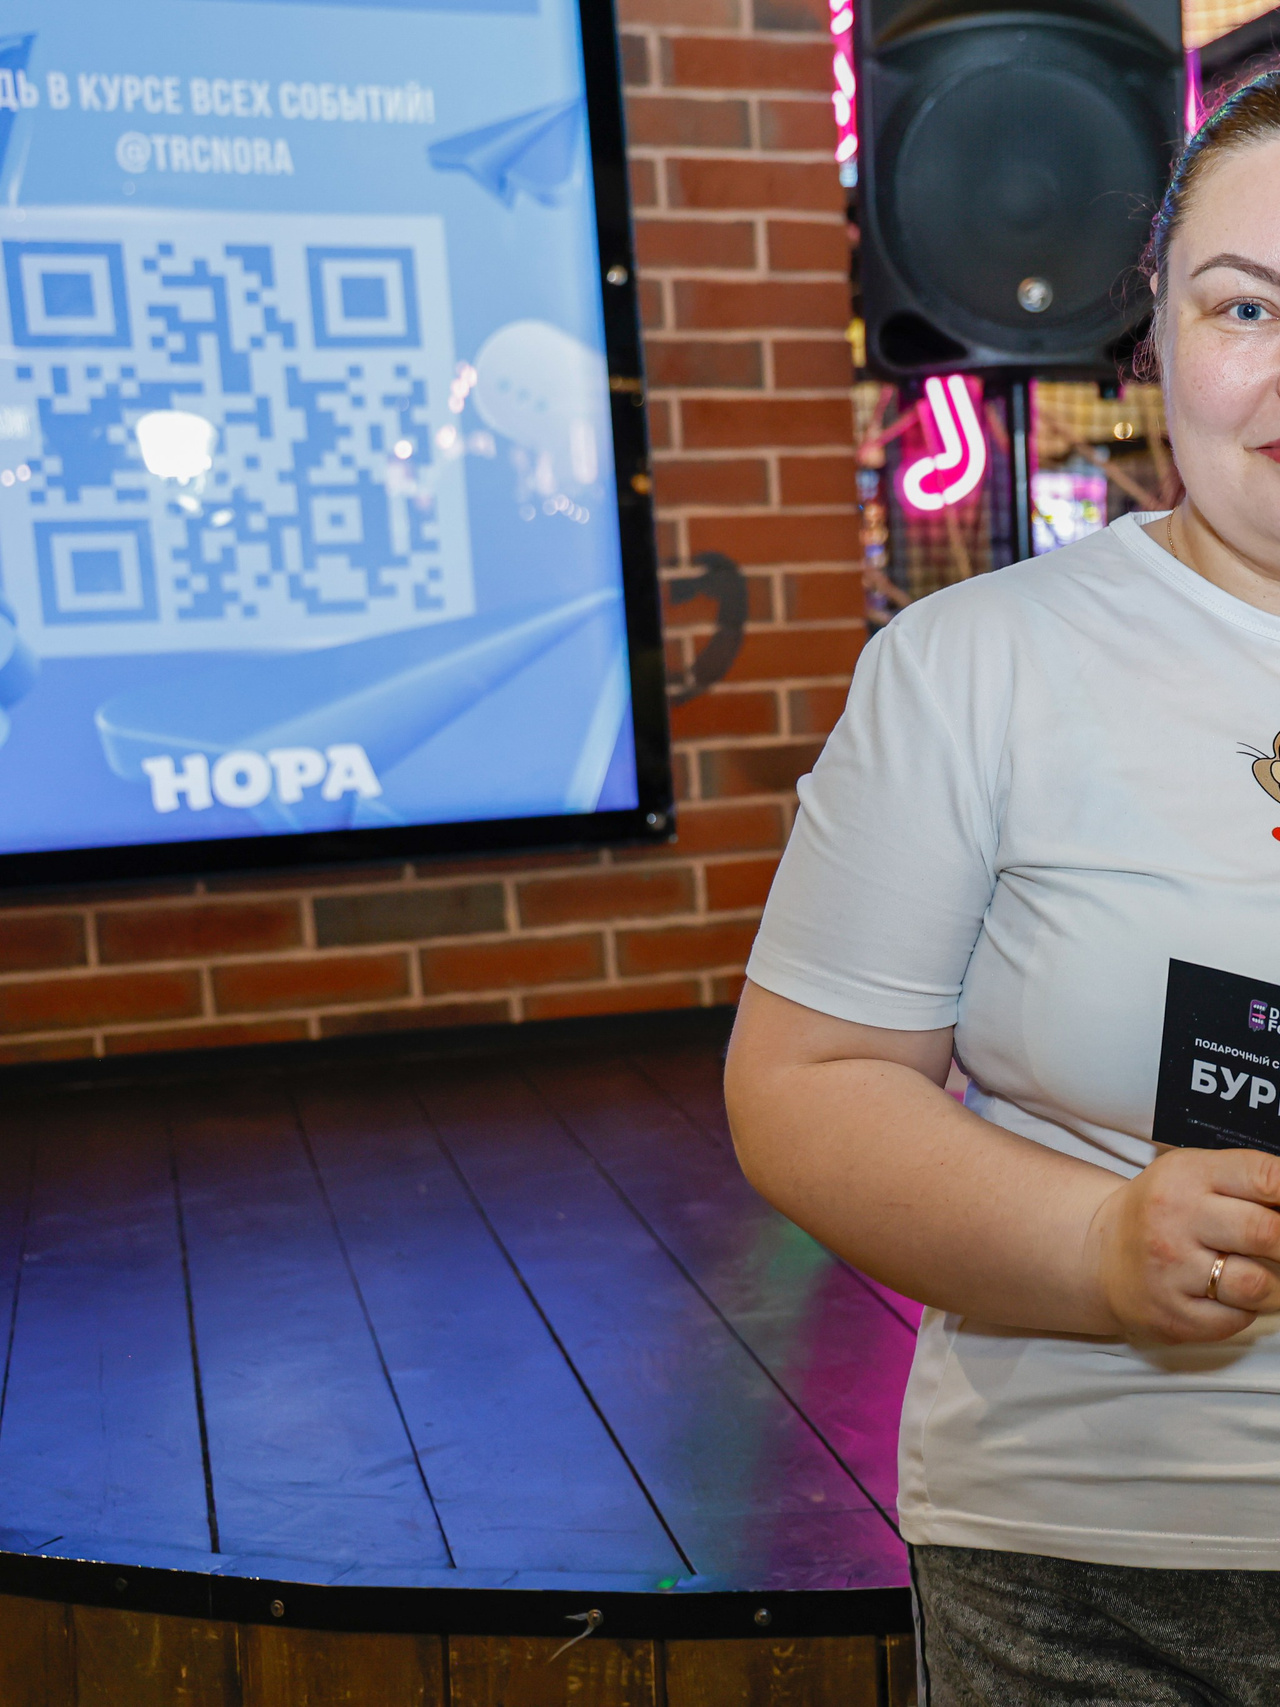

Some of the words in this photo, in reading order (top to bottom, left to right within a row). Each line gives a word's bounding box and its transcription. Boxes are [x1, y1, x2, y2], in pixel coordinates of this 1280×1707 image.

[46, 71, 71, 110] В
[77, 72, 184, 115] КУРСЕ
[189, 76, 273, 118] ВСЕХ
[278, 80, 435, 124] СОБЫТИЙ!
[115, 130, 295, 176] @TRCNORA
[141, 743, 383, 813] НОРА
[1194, 1037, 1270, 1067] ПОДАРОЧНЫЙ
